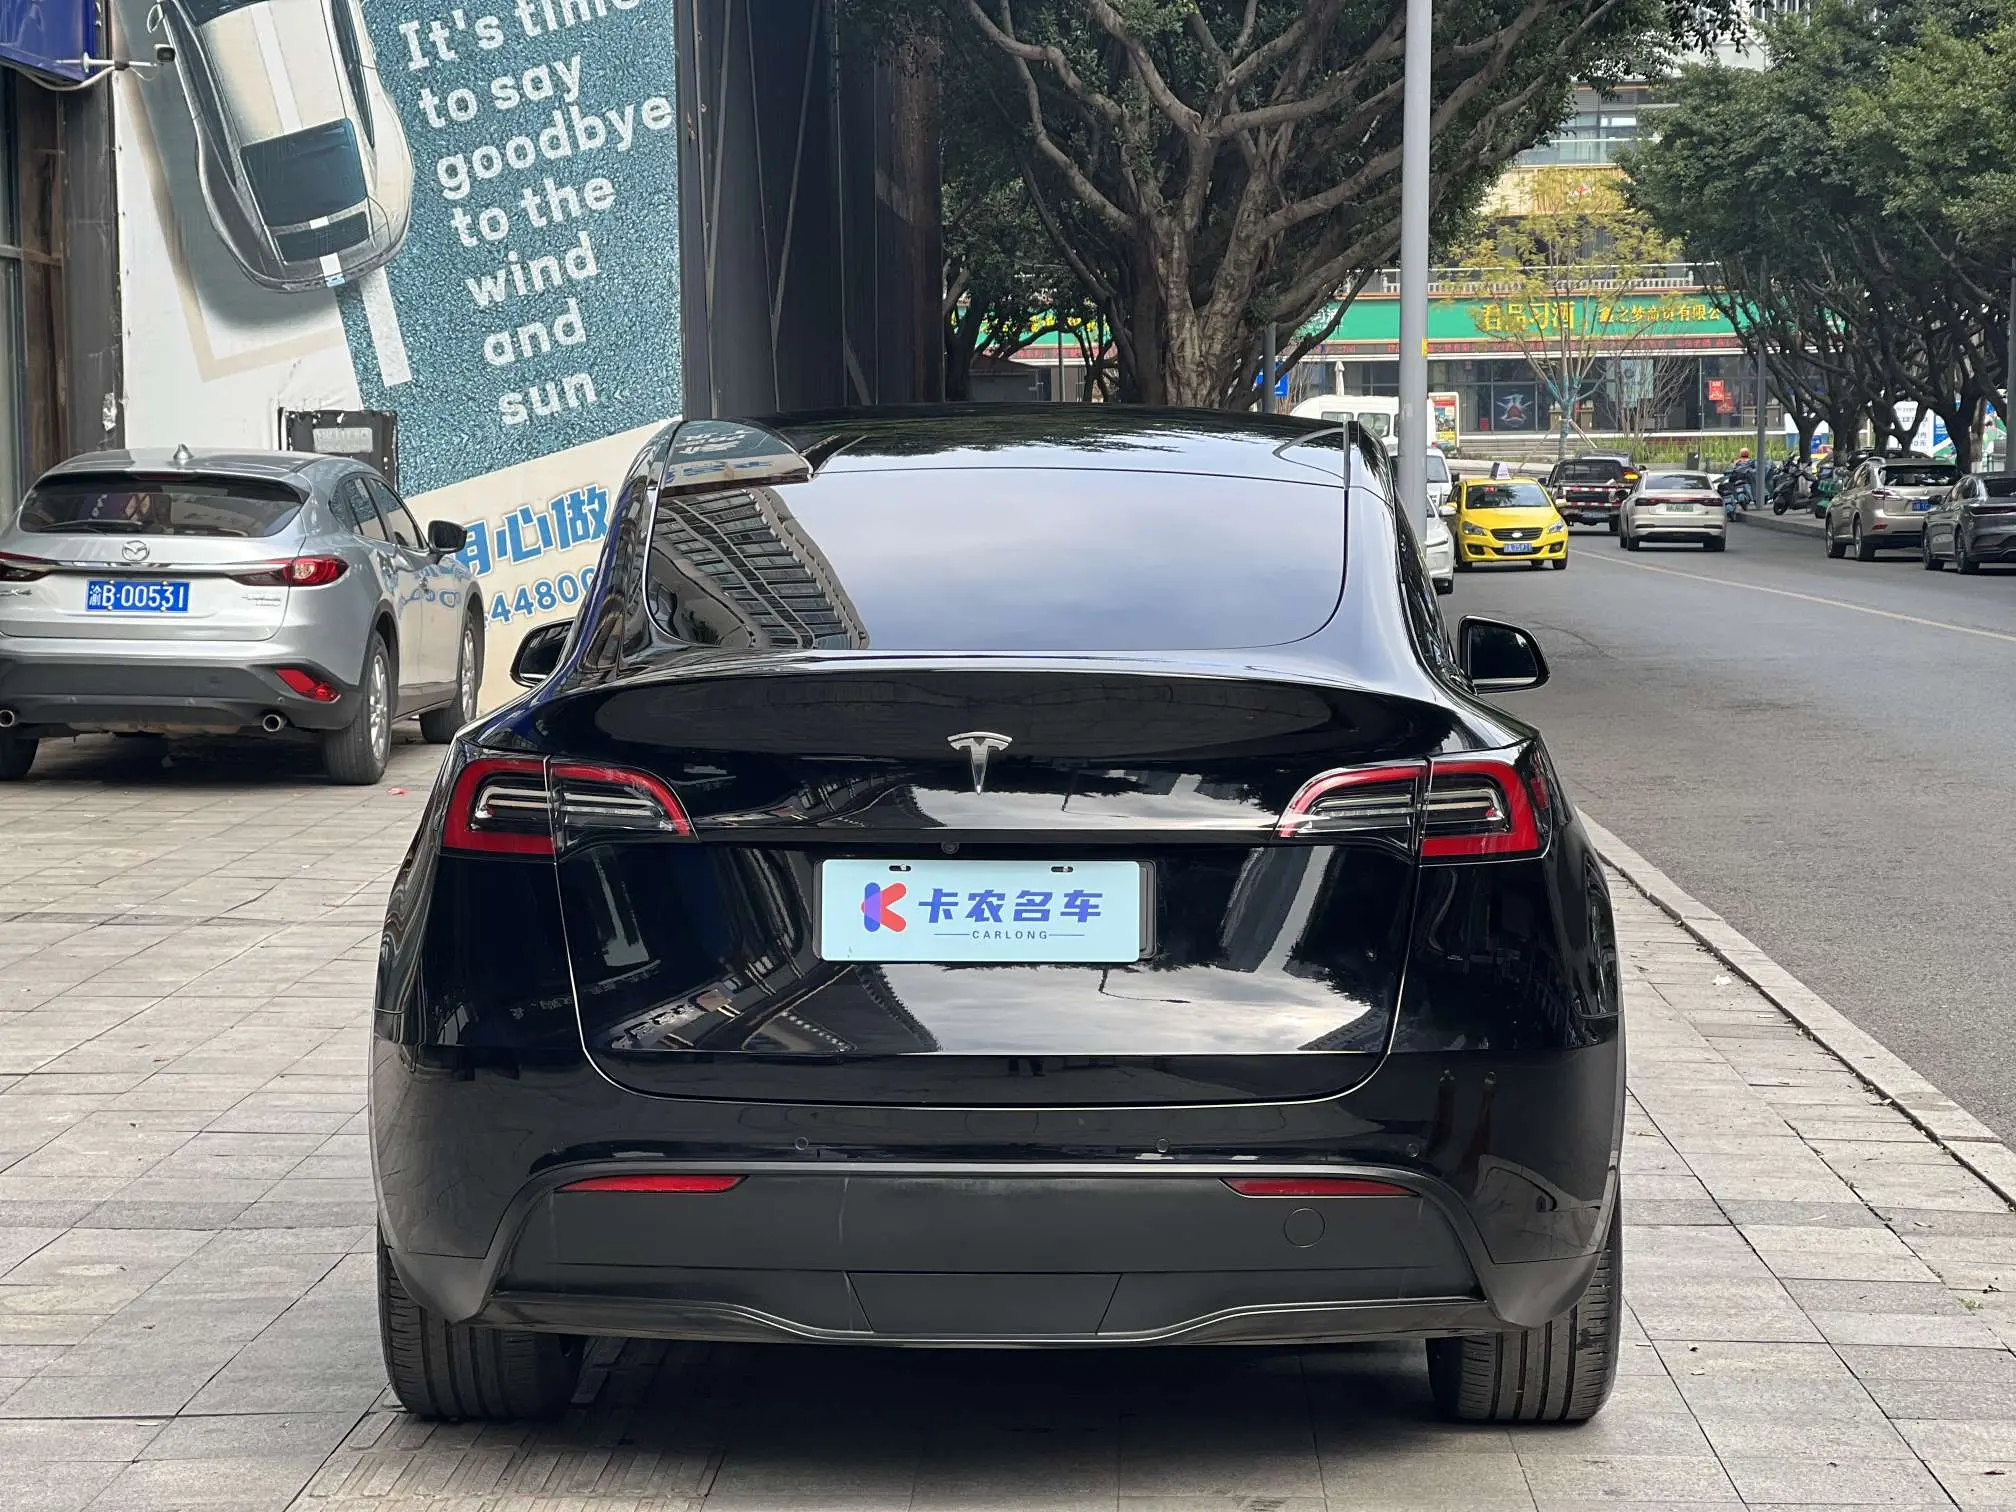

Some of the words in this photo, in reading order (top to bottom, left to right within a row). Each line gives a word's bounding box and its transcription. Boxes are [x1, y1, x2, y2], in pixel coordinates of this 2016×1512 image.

[399, 9, 504, 70] It's
[418, 88, 478, 128] to
[490, 52, 581, 110] say
[437, 97, 672, 200] goodbye
[451, 207, 510, 248] to
[520, 177, 616, 228] the
[465, 231, 600, 307] wind
[483, 297, 587, 366] and
[500, 372, 598, 425] sun
[918, 888, 1103, 924] 卡农名车
[972, 930, 1048, 940] CARLONG
